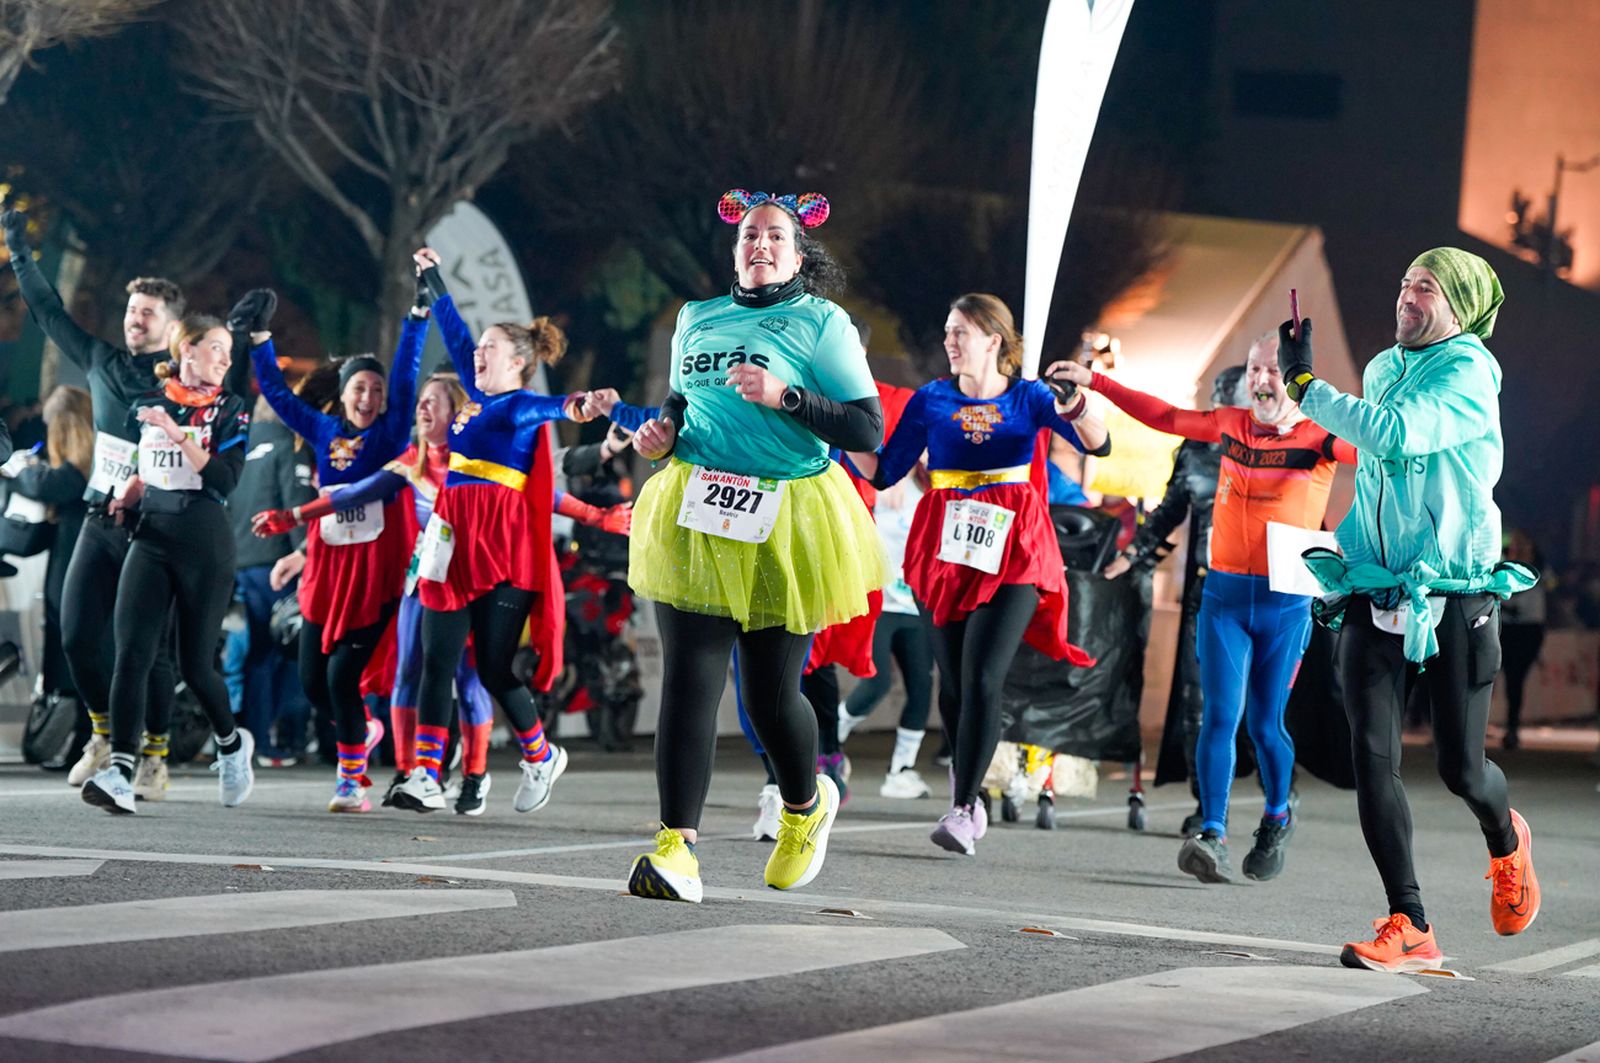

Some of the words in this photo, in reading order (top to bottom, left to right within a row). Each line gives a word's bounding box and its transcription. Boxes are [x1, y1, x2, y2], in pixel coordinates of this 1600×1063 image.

[681, 345, 770, 376] serás
[694, 378, 711, 388] QUE
[701, 472, 720, 482] SAN
[703, 483, 764, 514] 2927
